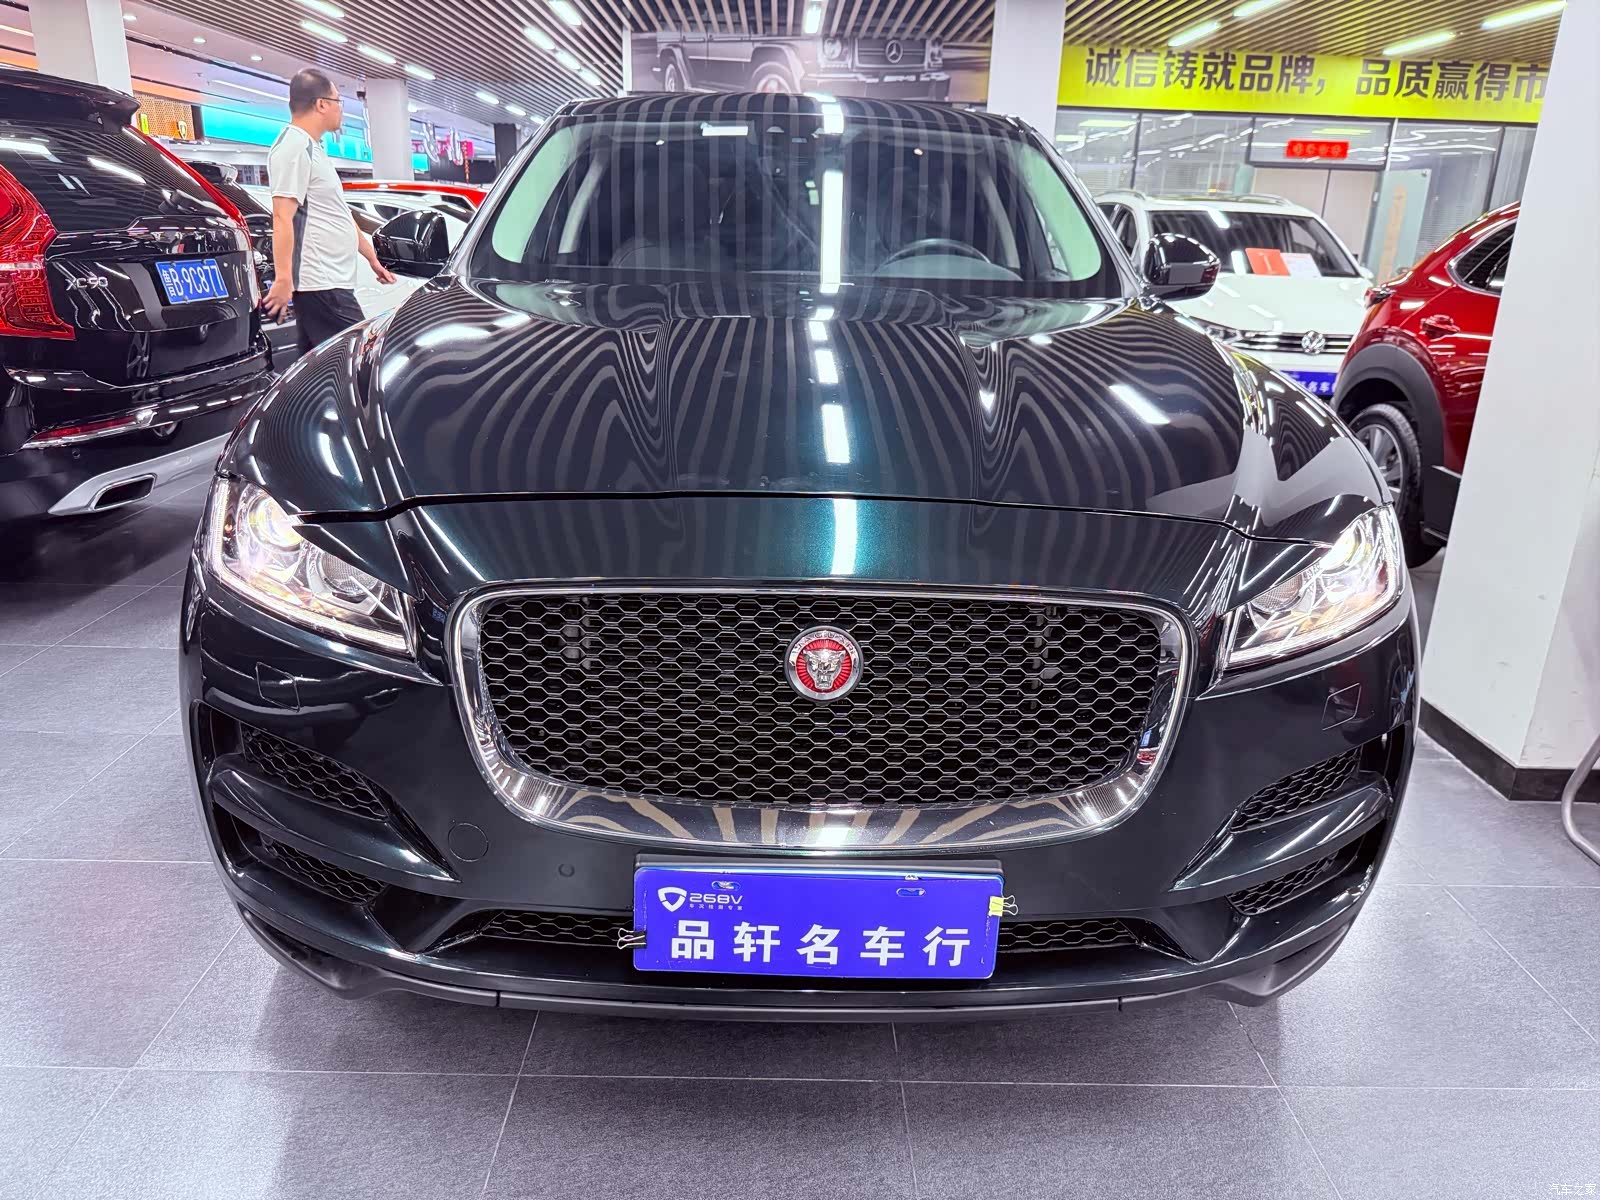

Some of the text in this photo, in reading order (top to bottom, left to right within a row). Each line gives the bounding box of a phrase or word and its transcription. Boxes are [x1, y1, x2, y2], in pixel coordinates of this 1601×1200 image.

[65, 276, 108, 291] XC90
[689, 892, 743, 904] 268V
[671, 919, 971, 967] 品轩名车行
